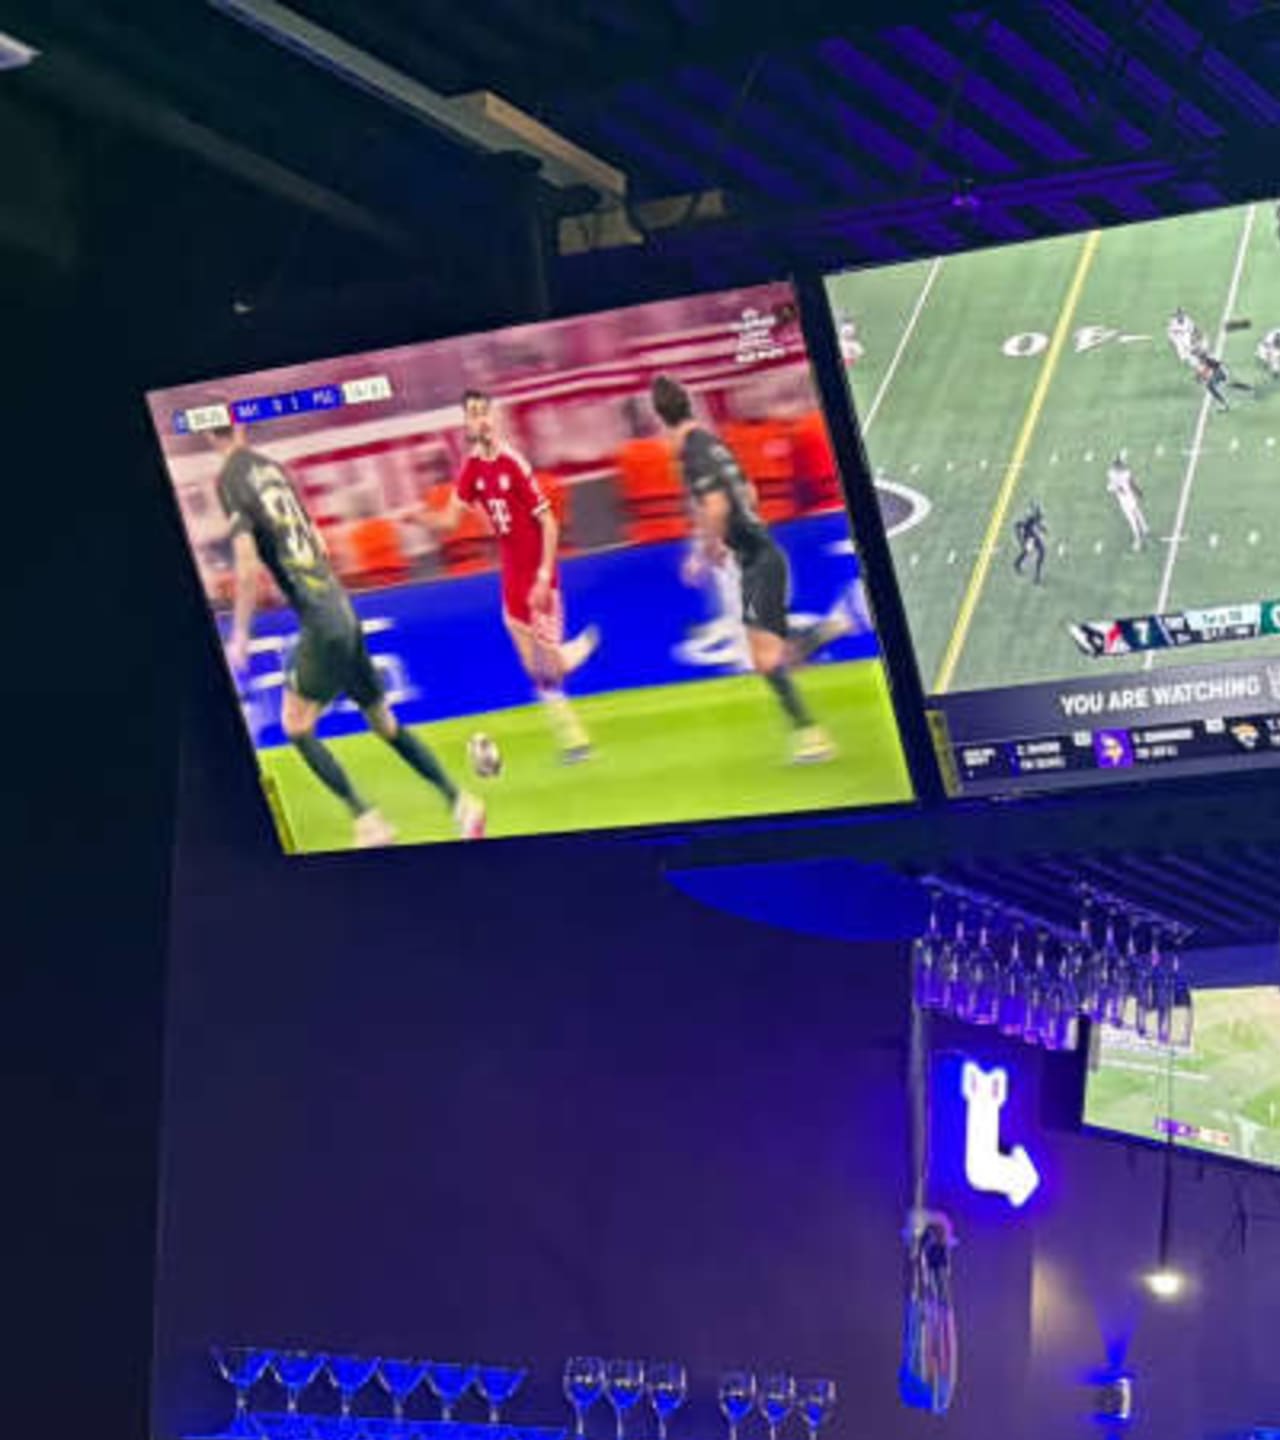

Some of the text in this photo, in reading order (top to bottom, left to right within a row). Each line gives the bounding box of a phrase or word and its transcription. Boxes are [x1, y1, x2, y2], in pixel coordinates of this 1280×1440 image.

[1132, 620, 1150, 645] 7
[1061, 692, 1103, 716] YOU
[1108, 687, 1149, 711] ARE
[1151, 676, 1261, 706] WATCHING
